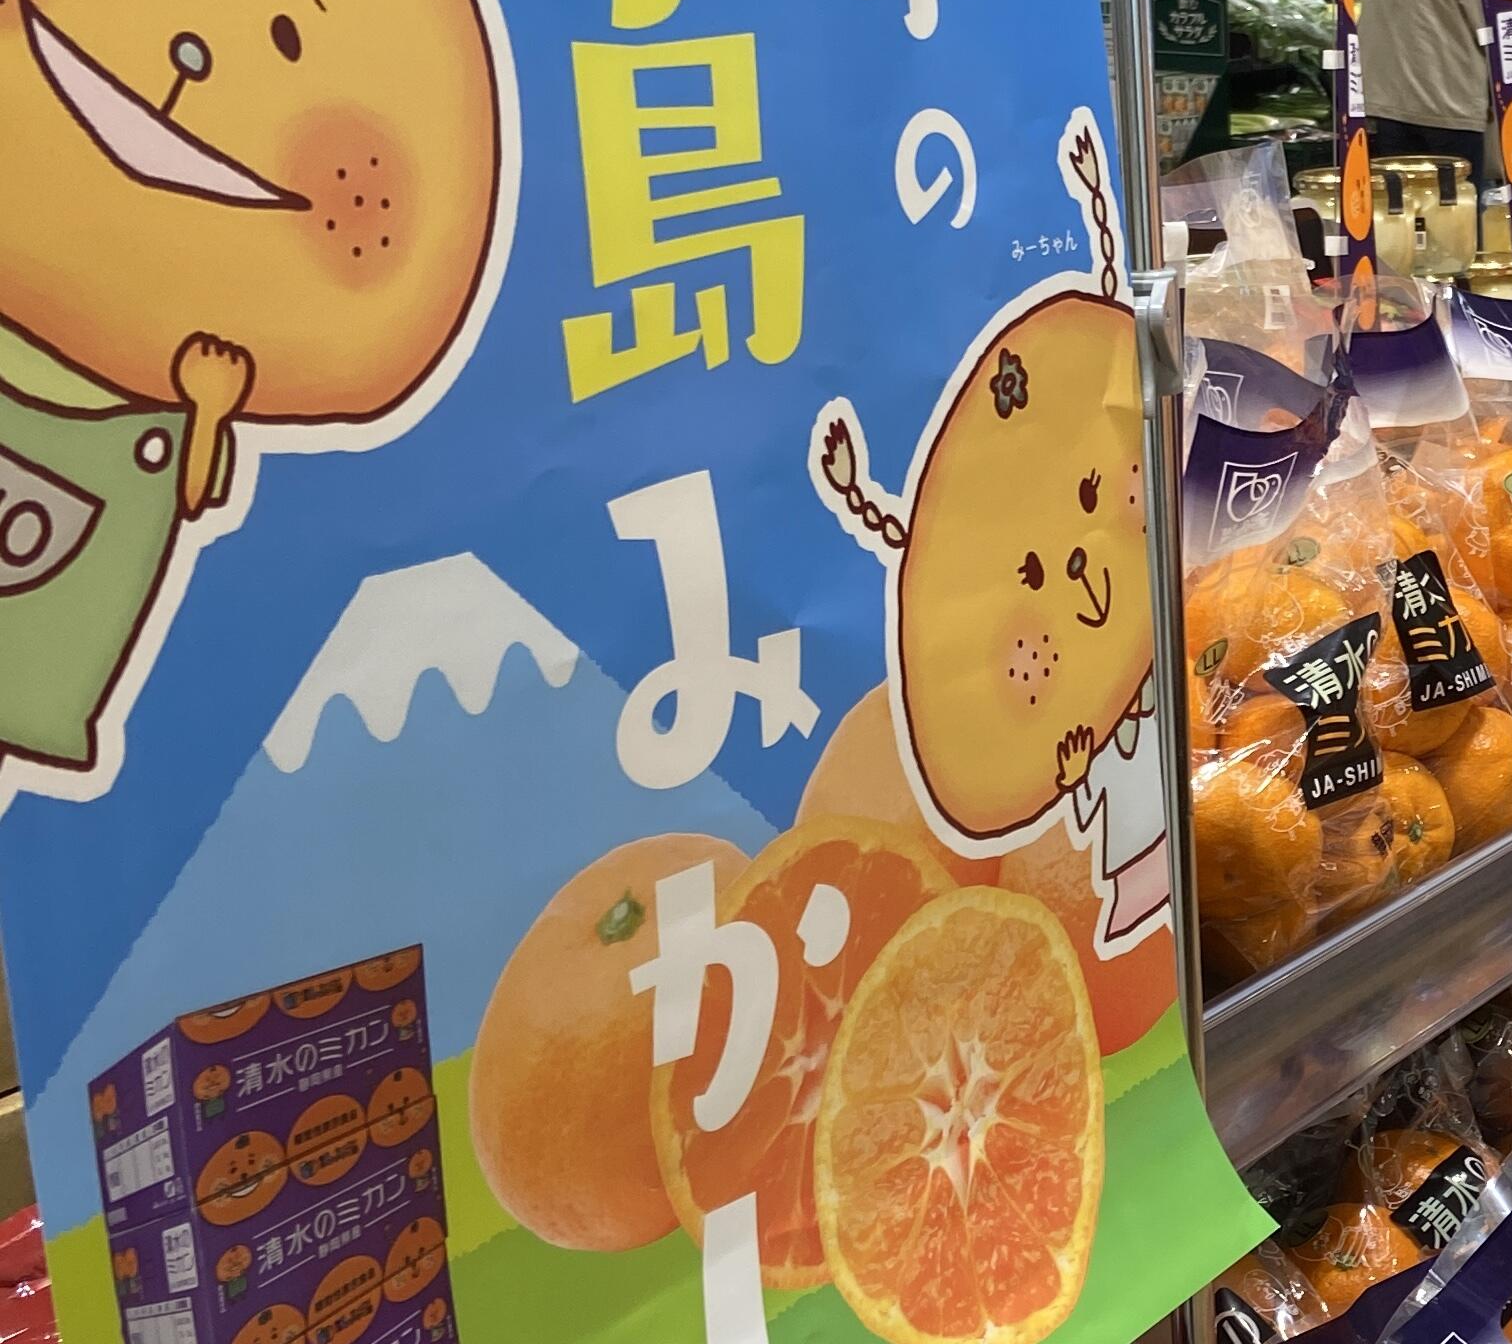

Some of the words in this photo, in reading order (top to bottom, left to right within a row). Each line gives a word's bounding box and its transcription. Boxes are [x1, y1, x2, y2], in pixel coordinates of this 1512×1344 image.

[1011, 234, 1078, 261] みーちゃん
[1202, 647, 1221, 671] LL
[1310, 759, 1383, 798] JA-SHI
[236, 1019, 389, 1098] 清水のミカン
[256, 1173, 406, 1275] 清水のミカン
